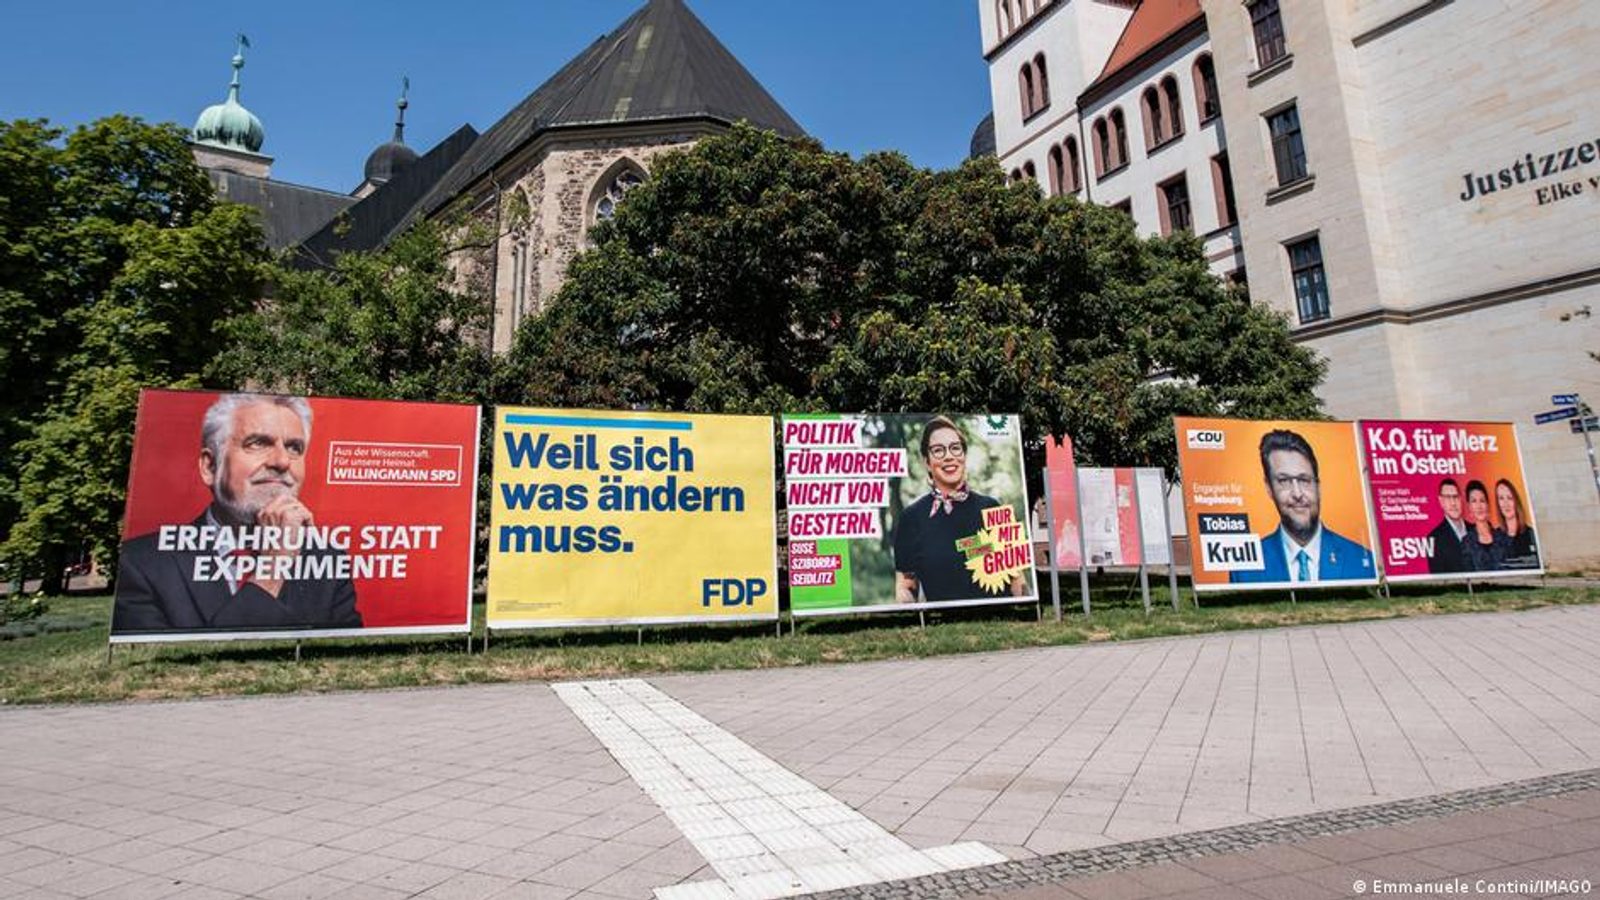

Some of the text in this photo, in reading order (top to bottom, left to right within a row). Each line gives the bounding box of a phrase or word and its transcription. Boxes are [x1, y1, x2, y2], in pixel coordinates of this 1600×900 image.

[1459, 138, 1600, 202] Justizze
[785, 423, 857, 444] POLITIK
[1197, 432, 1222, 442] CDU
[1368, 428, 1498, 452] K.O. für Merz
[334, 456, 348, 465] Für
[335, 447, 352, 456] Aus
[354, 448, 369, 457] der
[503, 431, 694, 472] Weil sich
[787, 448, 905, 475] FÜR MORGEN.
[333, 467, 457, 481] WILLINGMANN SPD
[1373, 453, 1467, 475] im Osten!
[500, 475, 744, 512] was ändern
[788, 481, 885, 505] NICHT VON
[1193, 495, 1243, 507] Magdeburg
[790, 511, 877, 536] GESTERN.
[986, 508, 1012, 528] NUR
[1203, 517, 1247, 531] Tobias
[158, 525, 443, 551] ERFAHRUNG STATT
[499, 524, 634, 553] muss.
[998, 524, 1021, 542] MIT
[983, 543, 1032, 575] GRÜN!
[1207, 541, 1258, 563] Krull
[1390, 537, 1435, 560] BSW
[193, 554, 408, 581] EXPERIMENTE
[792, 572, 832, 585] SEIDLITZ
[702, 578, 767, 607] FDP
